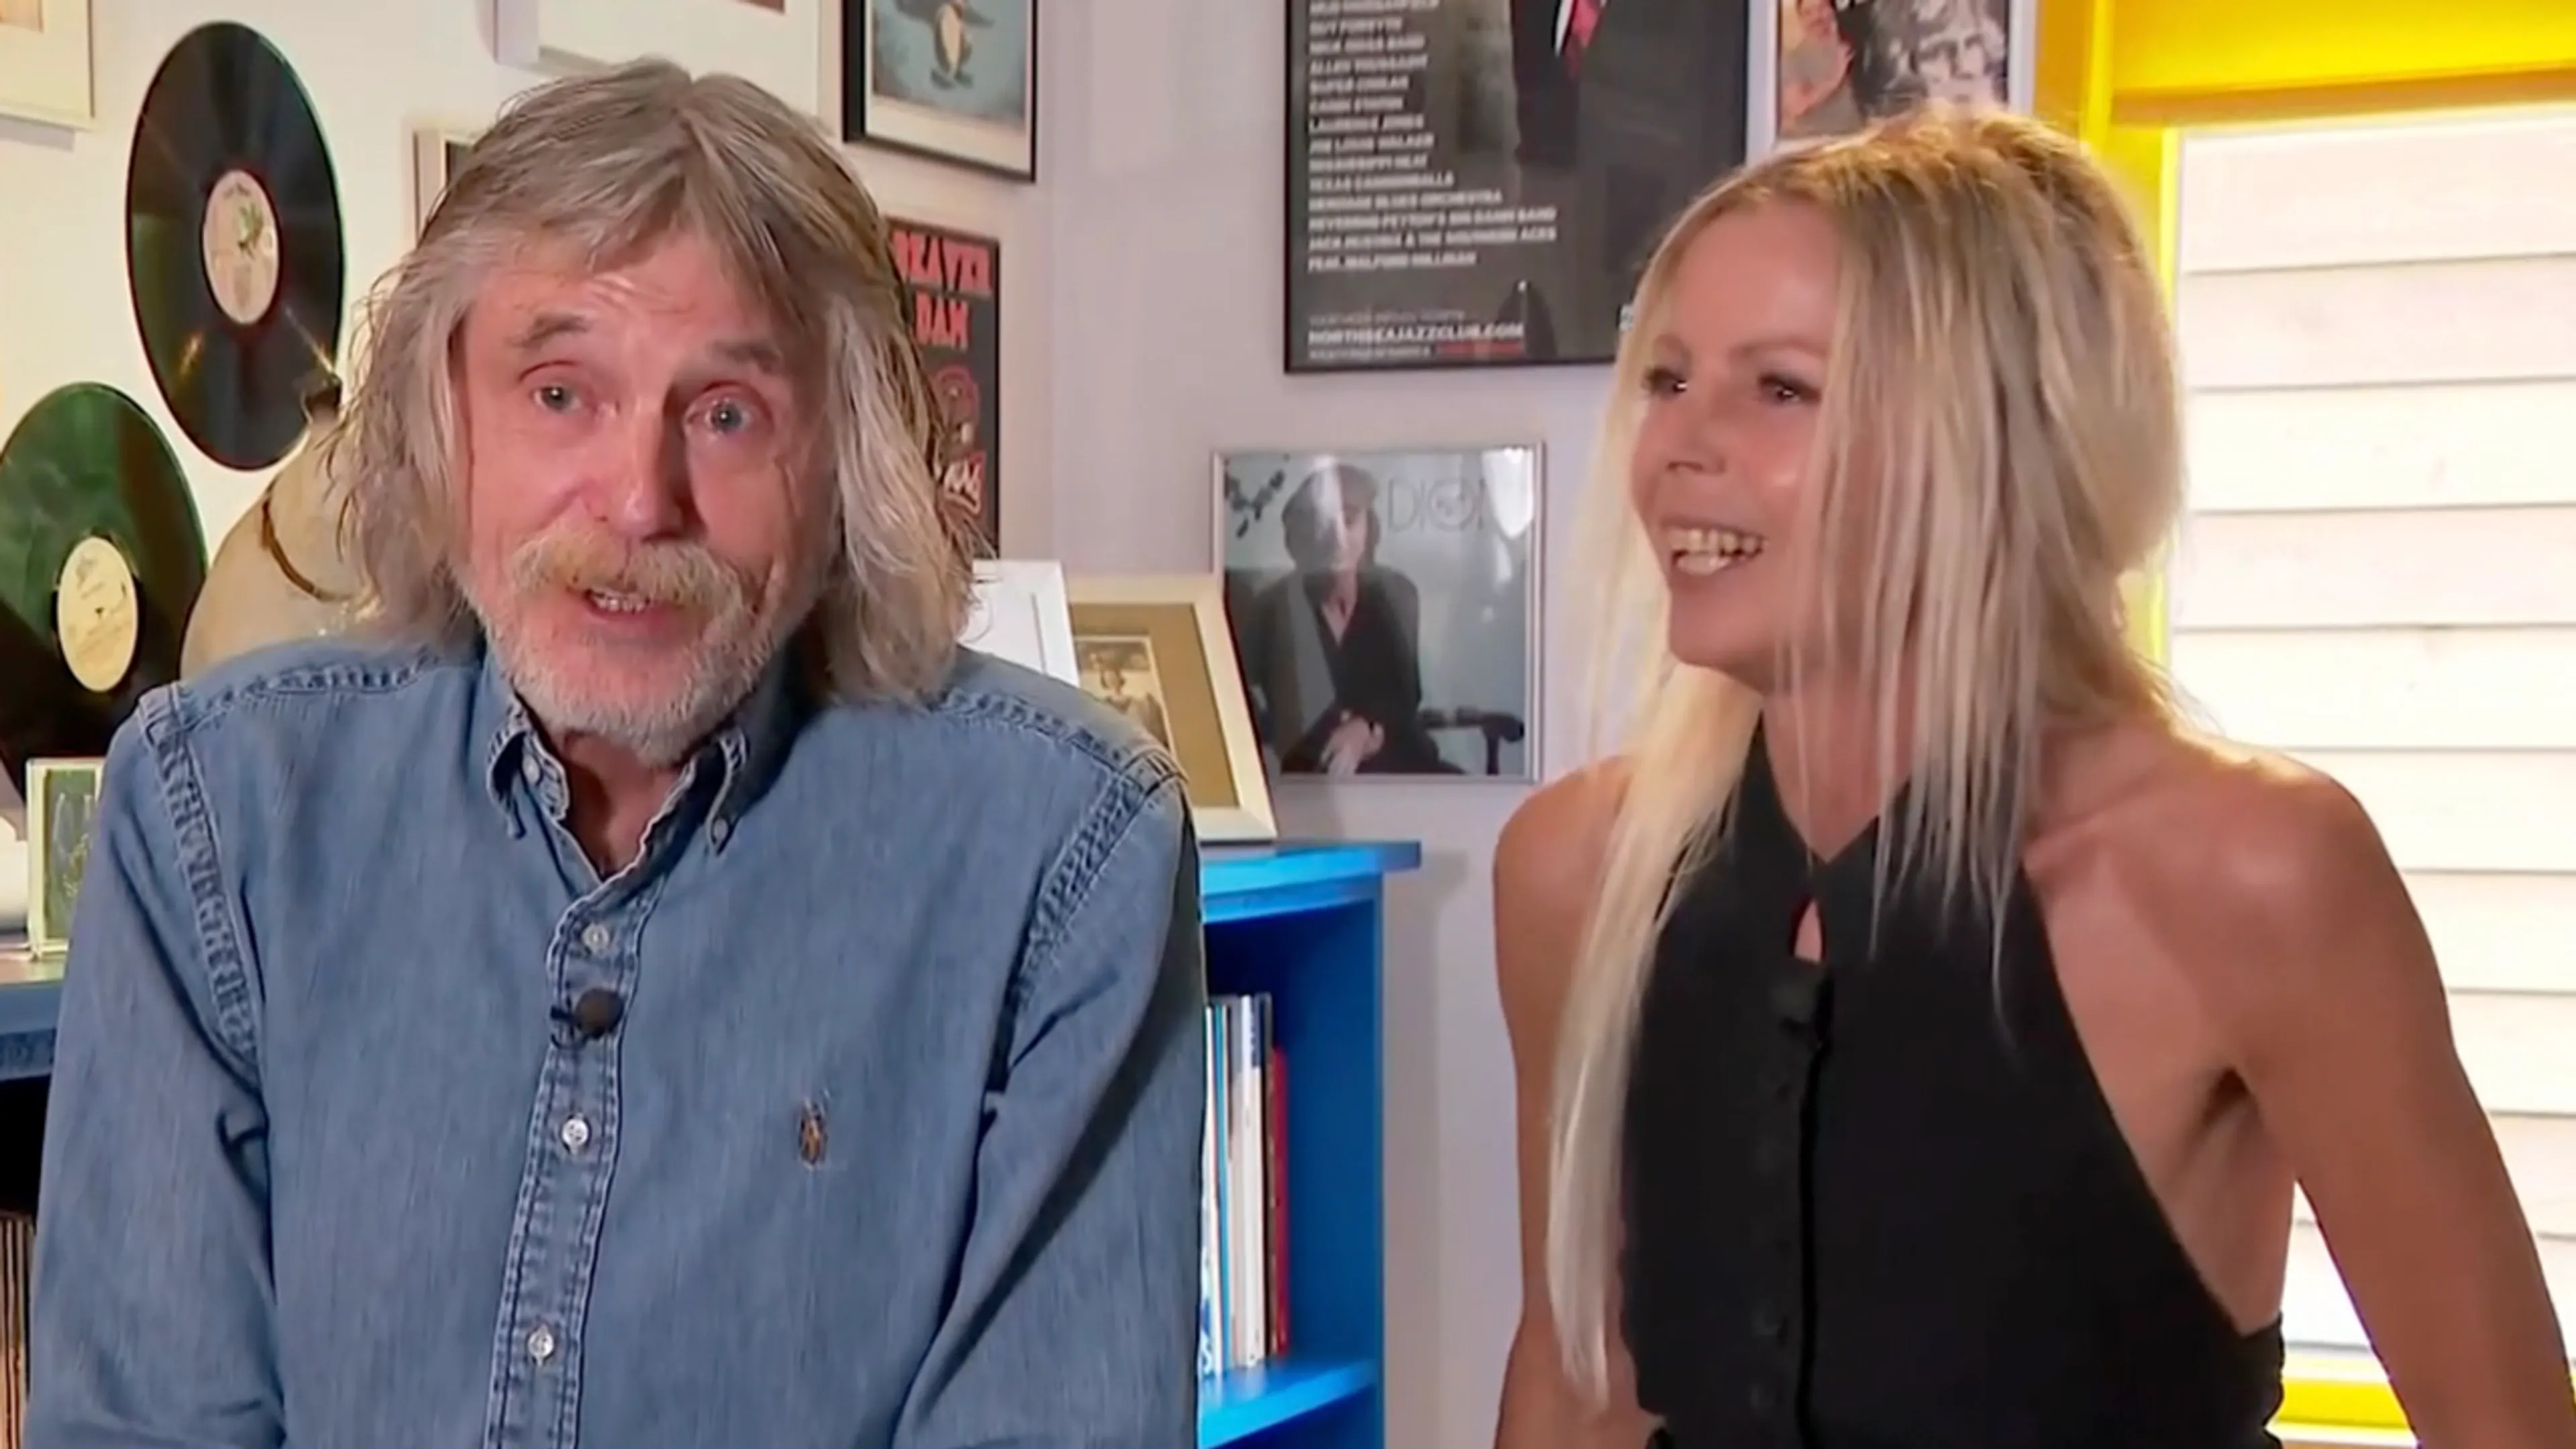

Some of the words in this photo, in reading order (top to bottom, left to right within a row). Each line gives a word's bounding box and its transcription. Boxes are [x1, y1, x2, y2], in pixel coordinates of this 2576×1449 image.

[1518, 205, 1557, 223] BAND
[1405, 232, 1415, 248] &
[1417, 231, 1441, 248] THE
[1520, 225, 1557, 242] ACES
[916, 290, 969, 352] DAM
